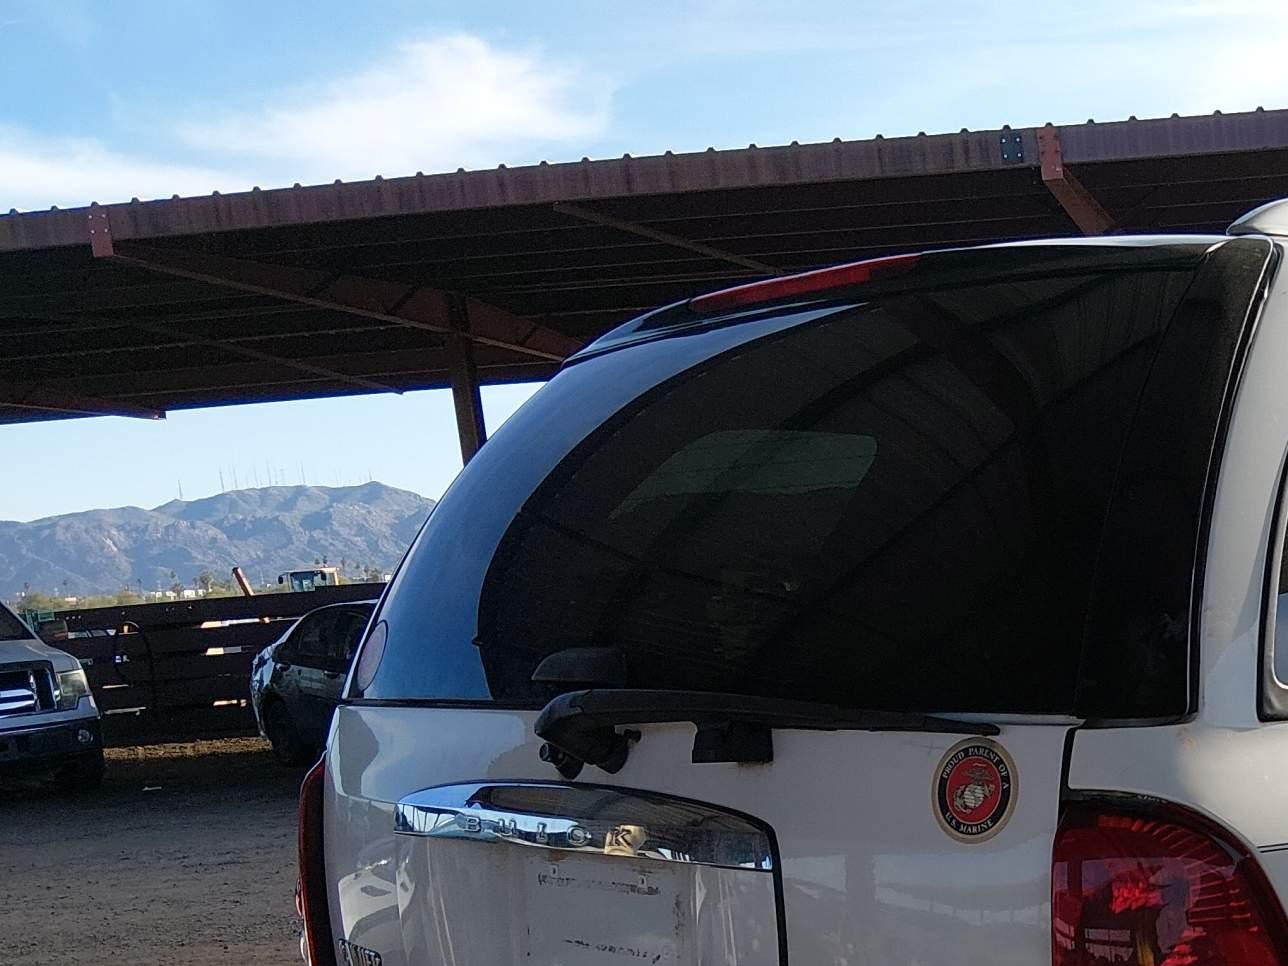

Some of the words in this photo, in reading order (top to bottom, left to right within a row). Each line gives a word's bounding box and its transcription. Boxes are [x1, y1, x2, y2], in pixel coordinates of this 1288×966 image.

[942, 751, 965, 779] PROUD
[968, 747, 999, 763] PARENT
[998, 763, 1009, 778] OF
[463, 814, 634, 849] BUICK
[958, 818, 994, 834] MARINE
